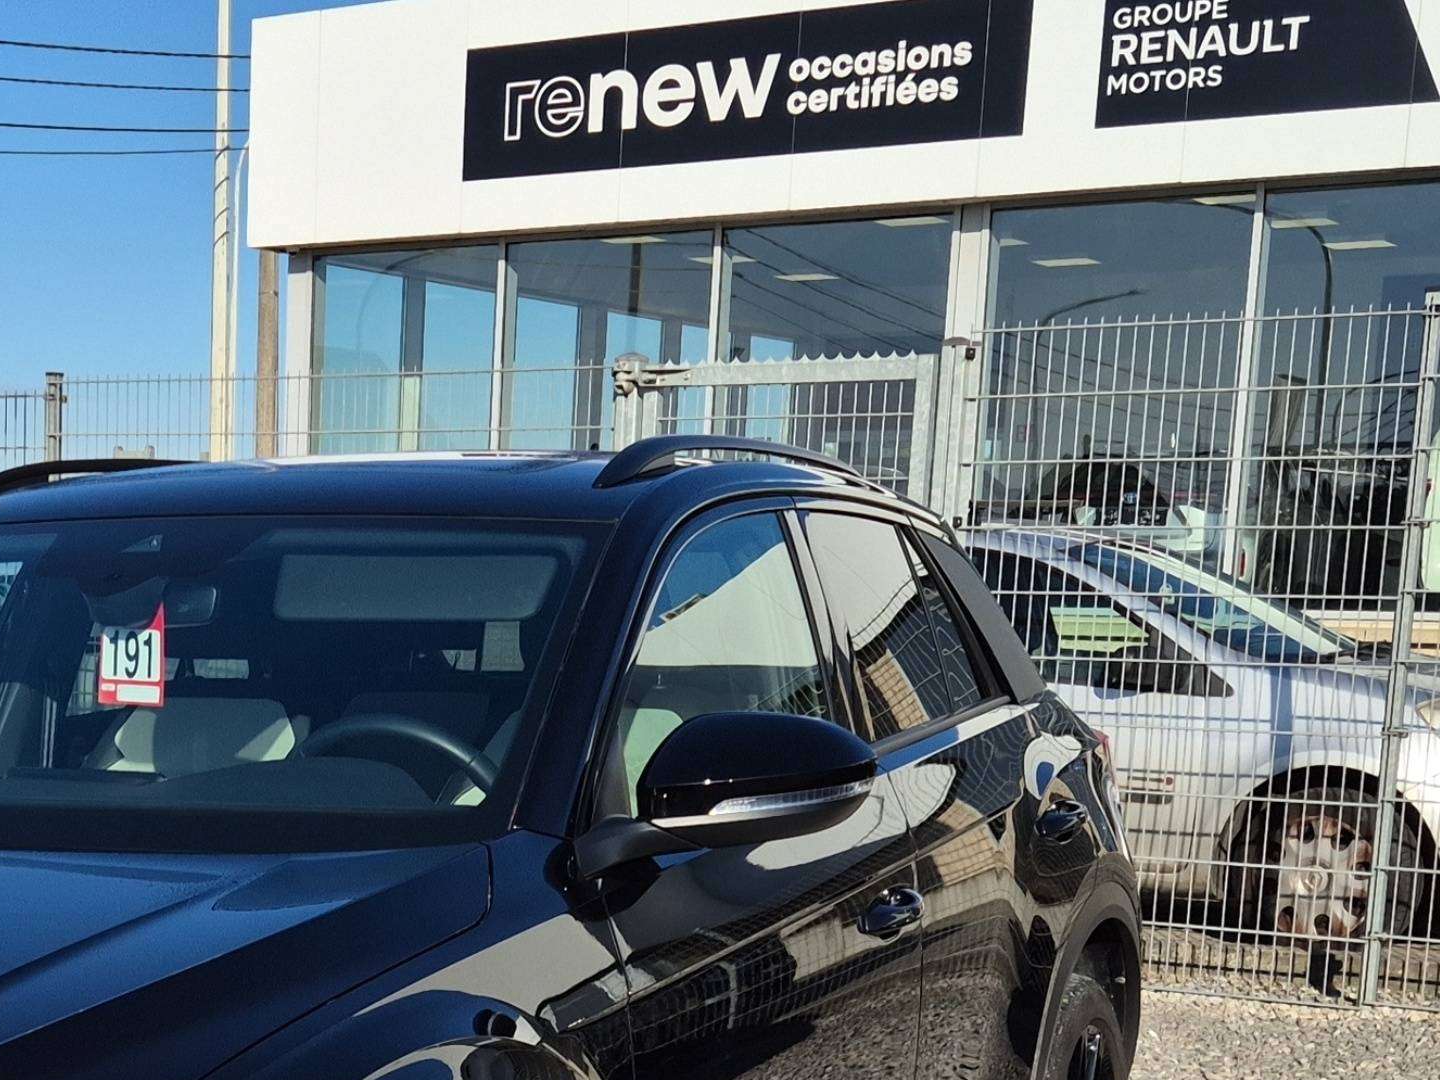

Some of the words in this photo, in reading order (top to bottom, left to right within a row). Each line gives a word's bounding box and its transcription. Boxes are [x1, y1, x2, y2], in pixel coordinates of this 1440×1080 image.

[1113, 0, 1229, 29] GROUPE
[788, 40, 973, 82] occasions
[1111, 16, 1311, 67] RENAULT
[503, 53, 782, 142] renew
[785, 74, 959, 115] certifiées
[1106, 65, 1224, 96] MOTORS
[109, 630, 153, 679] 191
